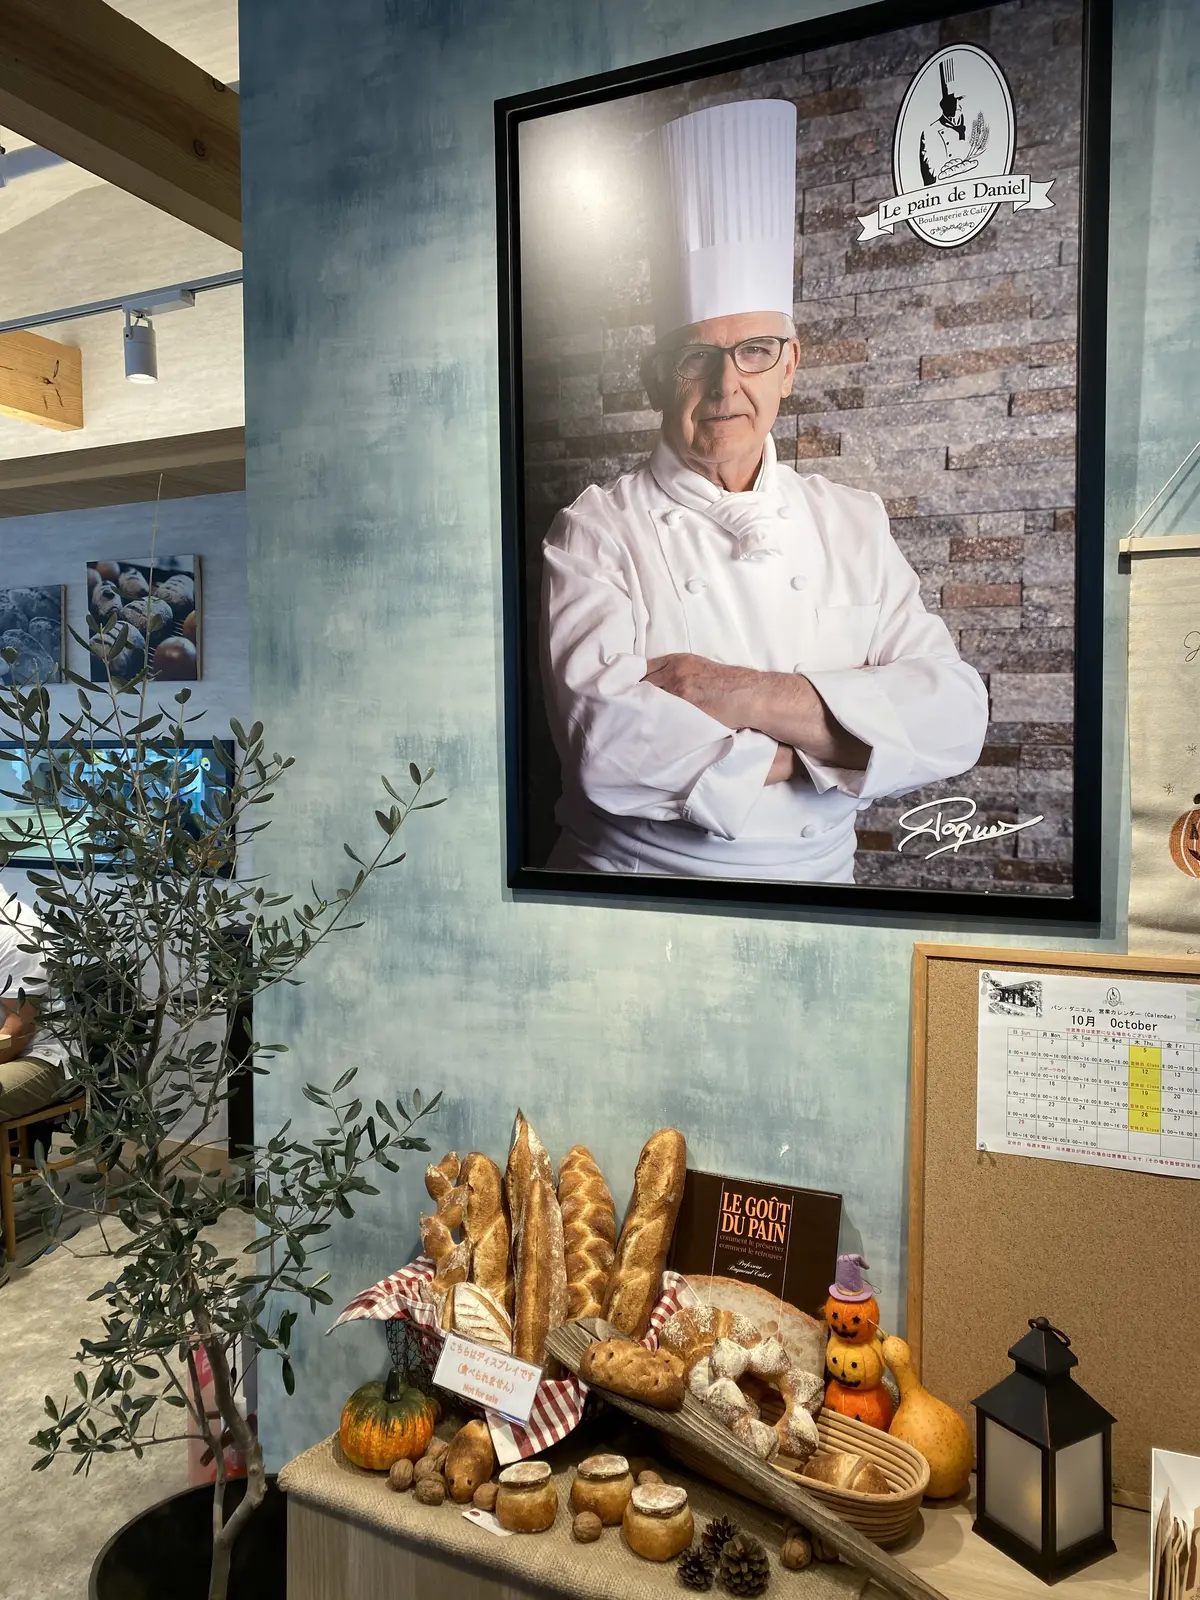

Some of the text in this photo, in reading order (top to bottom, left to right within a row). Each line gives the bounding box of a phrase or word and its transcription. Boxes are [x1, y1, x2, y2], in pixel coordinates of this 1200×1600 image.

[883, 178, 1027, 221] Le pain de Daniel
[918, 210, 962, 225] Boulangerie
[970, 206, 988, 216] Café
[1072, 1015, 1158, 1031] 10月 October
[722, 1192, 791, 1223] LE GOÛT
[721, 1212, 786, 1244] DU PAIN
[719, 1235, 748, 1245] comment
[719, 1243, 747, 1253] comment
[755, 1250, 783, 1260] retrouver
[449, 1342, 536, 1382] こちらはディスプレイです
[462, 1383, 476, 1395] Not
[475, 1388, 485, 1398] for
